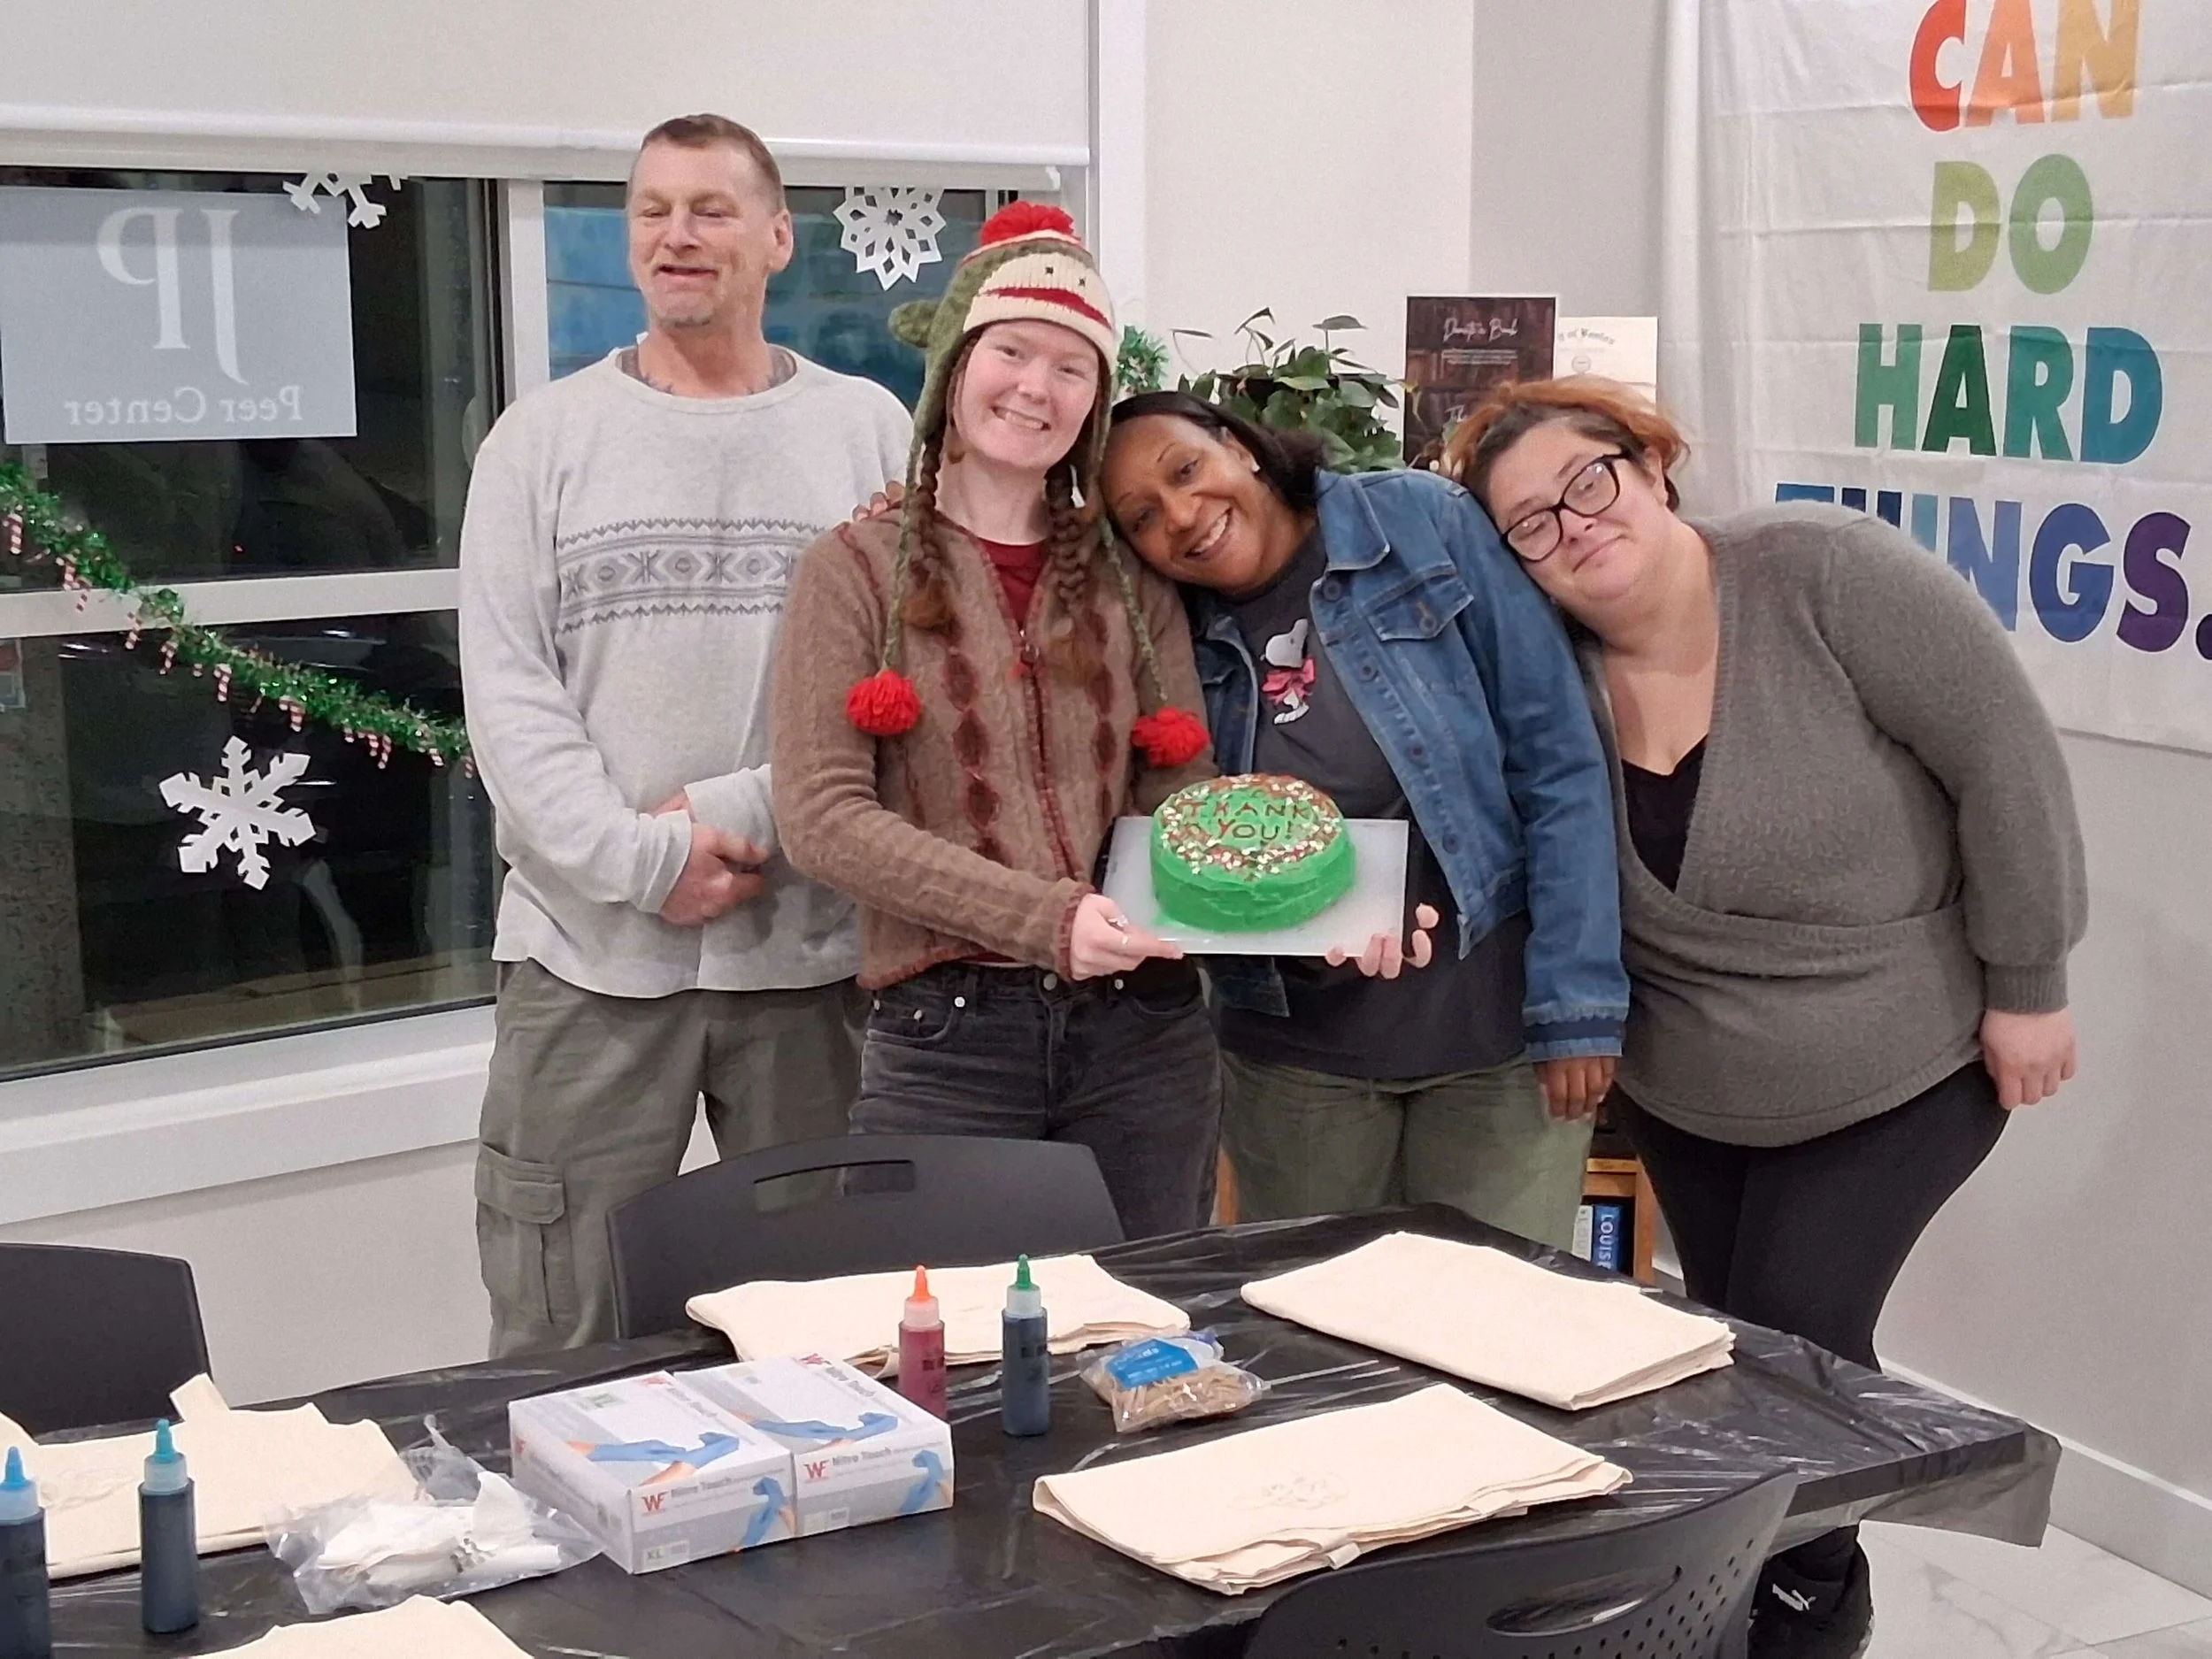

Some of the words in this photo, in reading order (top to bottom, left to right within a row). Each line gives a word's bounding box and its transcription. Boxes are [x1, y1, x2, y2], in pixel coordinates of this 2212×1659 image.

[1909, 0, 2139, 132] CAN
[1927, 154, 2093, 295] DO
[1855, 323, 2162, 465] HARD
[1178, 799, 1310, 819] THANK
[1217, 818, 1293, 840] YOU!
